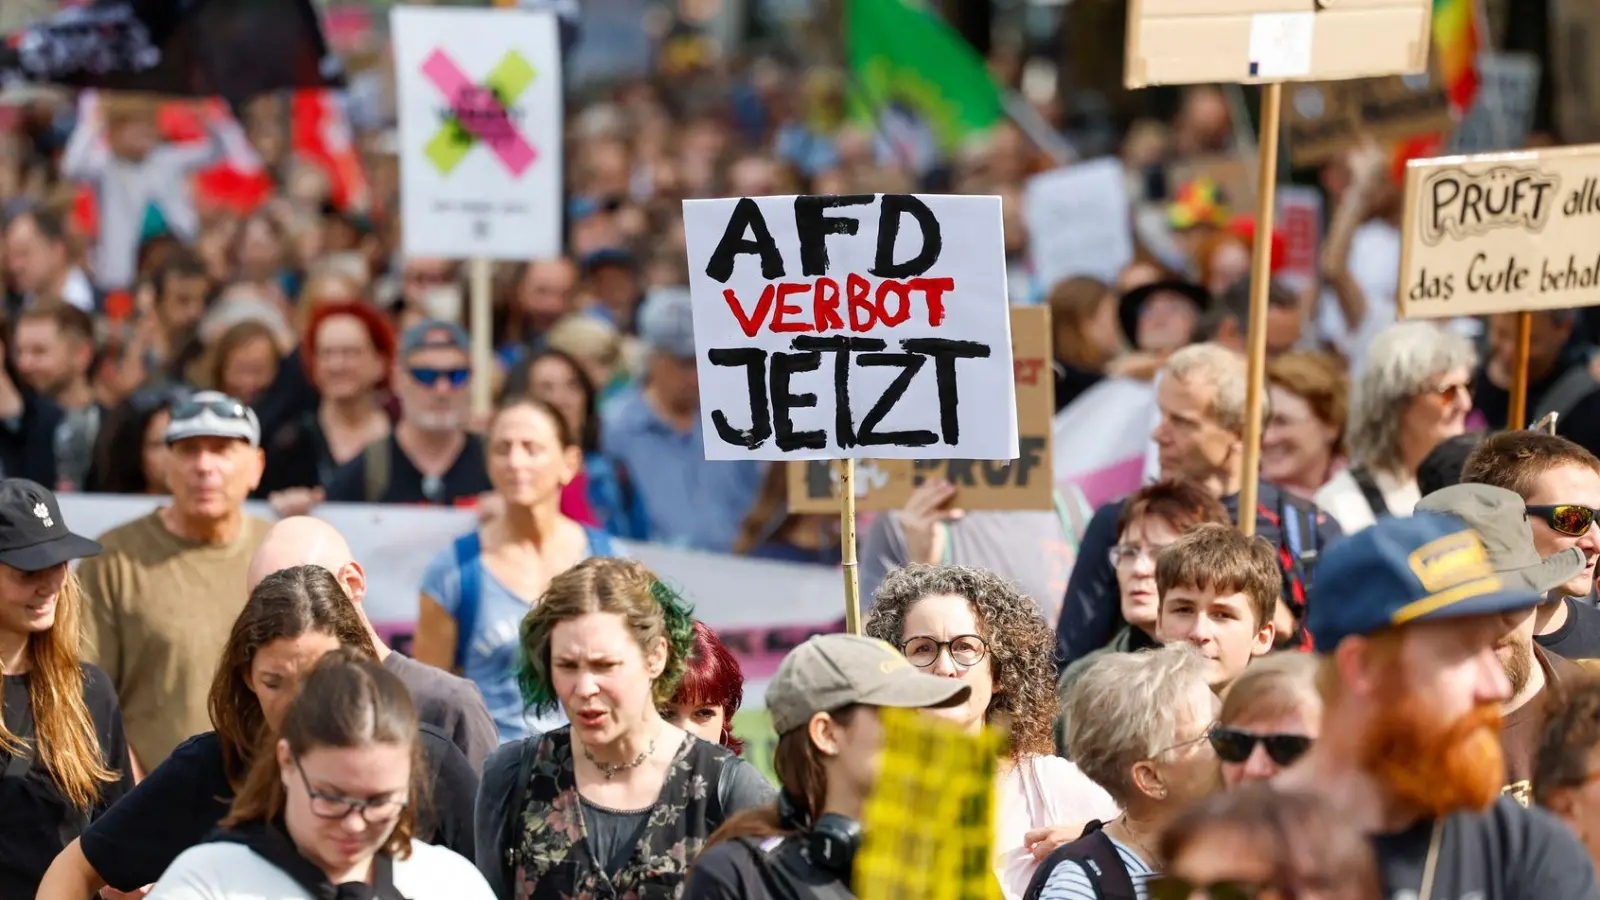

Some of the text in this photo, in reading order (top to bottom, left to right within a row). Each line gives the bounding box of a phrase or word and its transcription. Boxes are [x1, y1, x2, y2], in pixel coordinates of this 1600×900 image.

[1432, 173, 1552, 230] PRÜFT
[705, 194, 942, 283] AFD
[723, 273, 955, 337] VERBOT
[1409, 266, 1454, 301] das
[708, 335, 991, 452] JETZT
